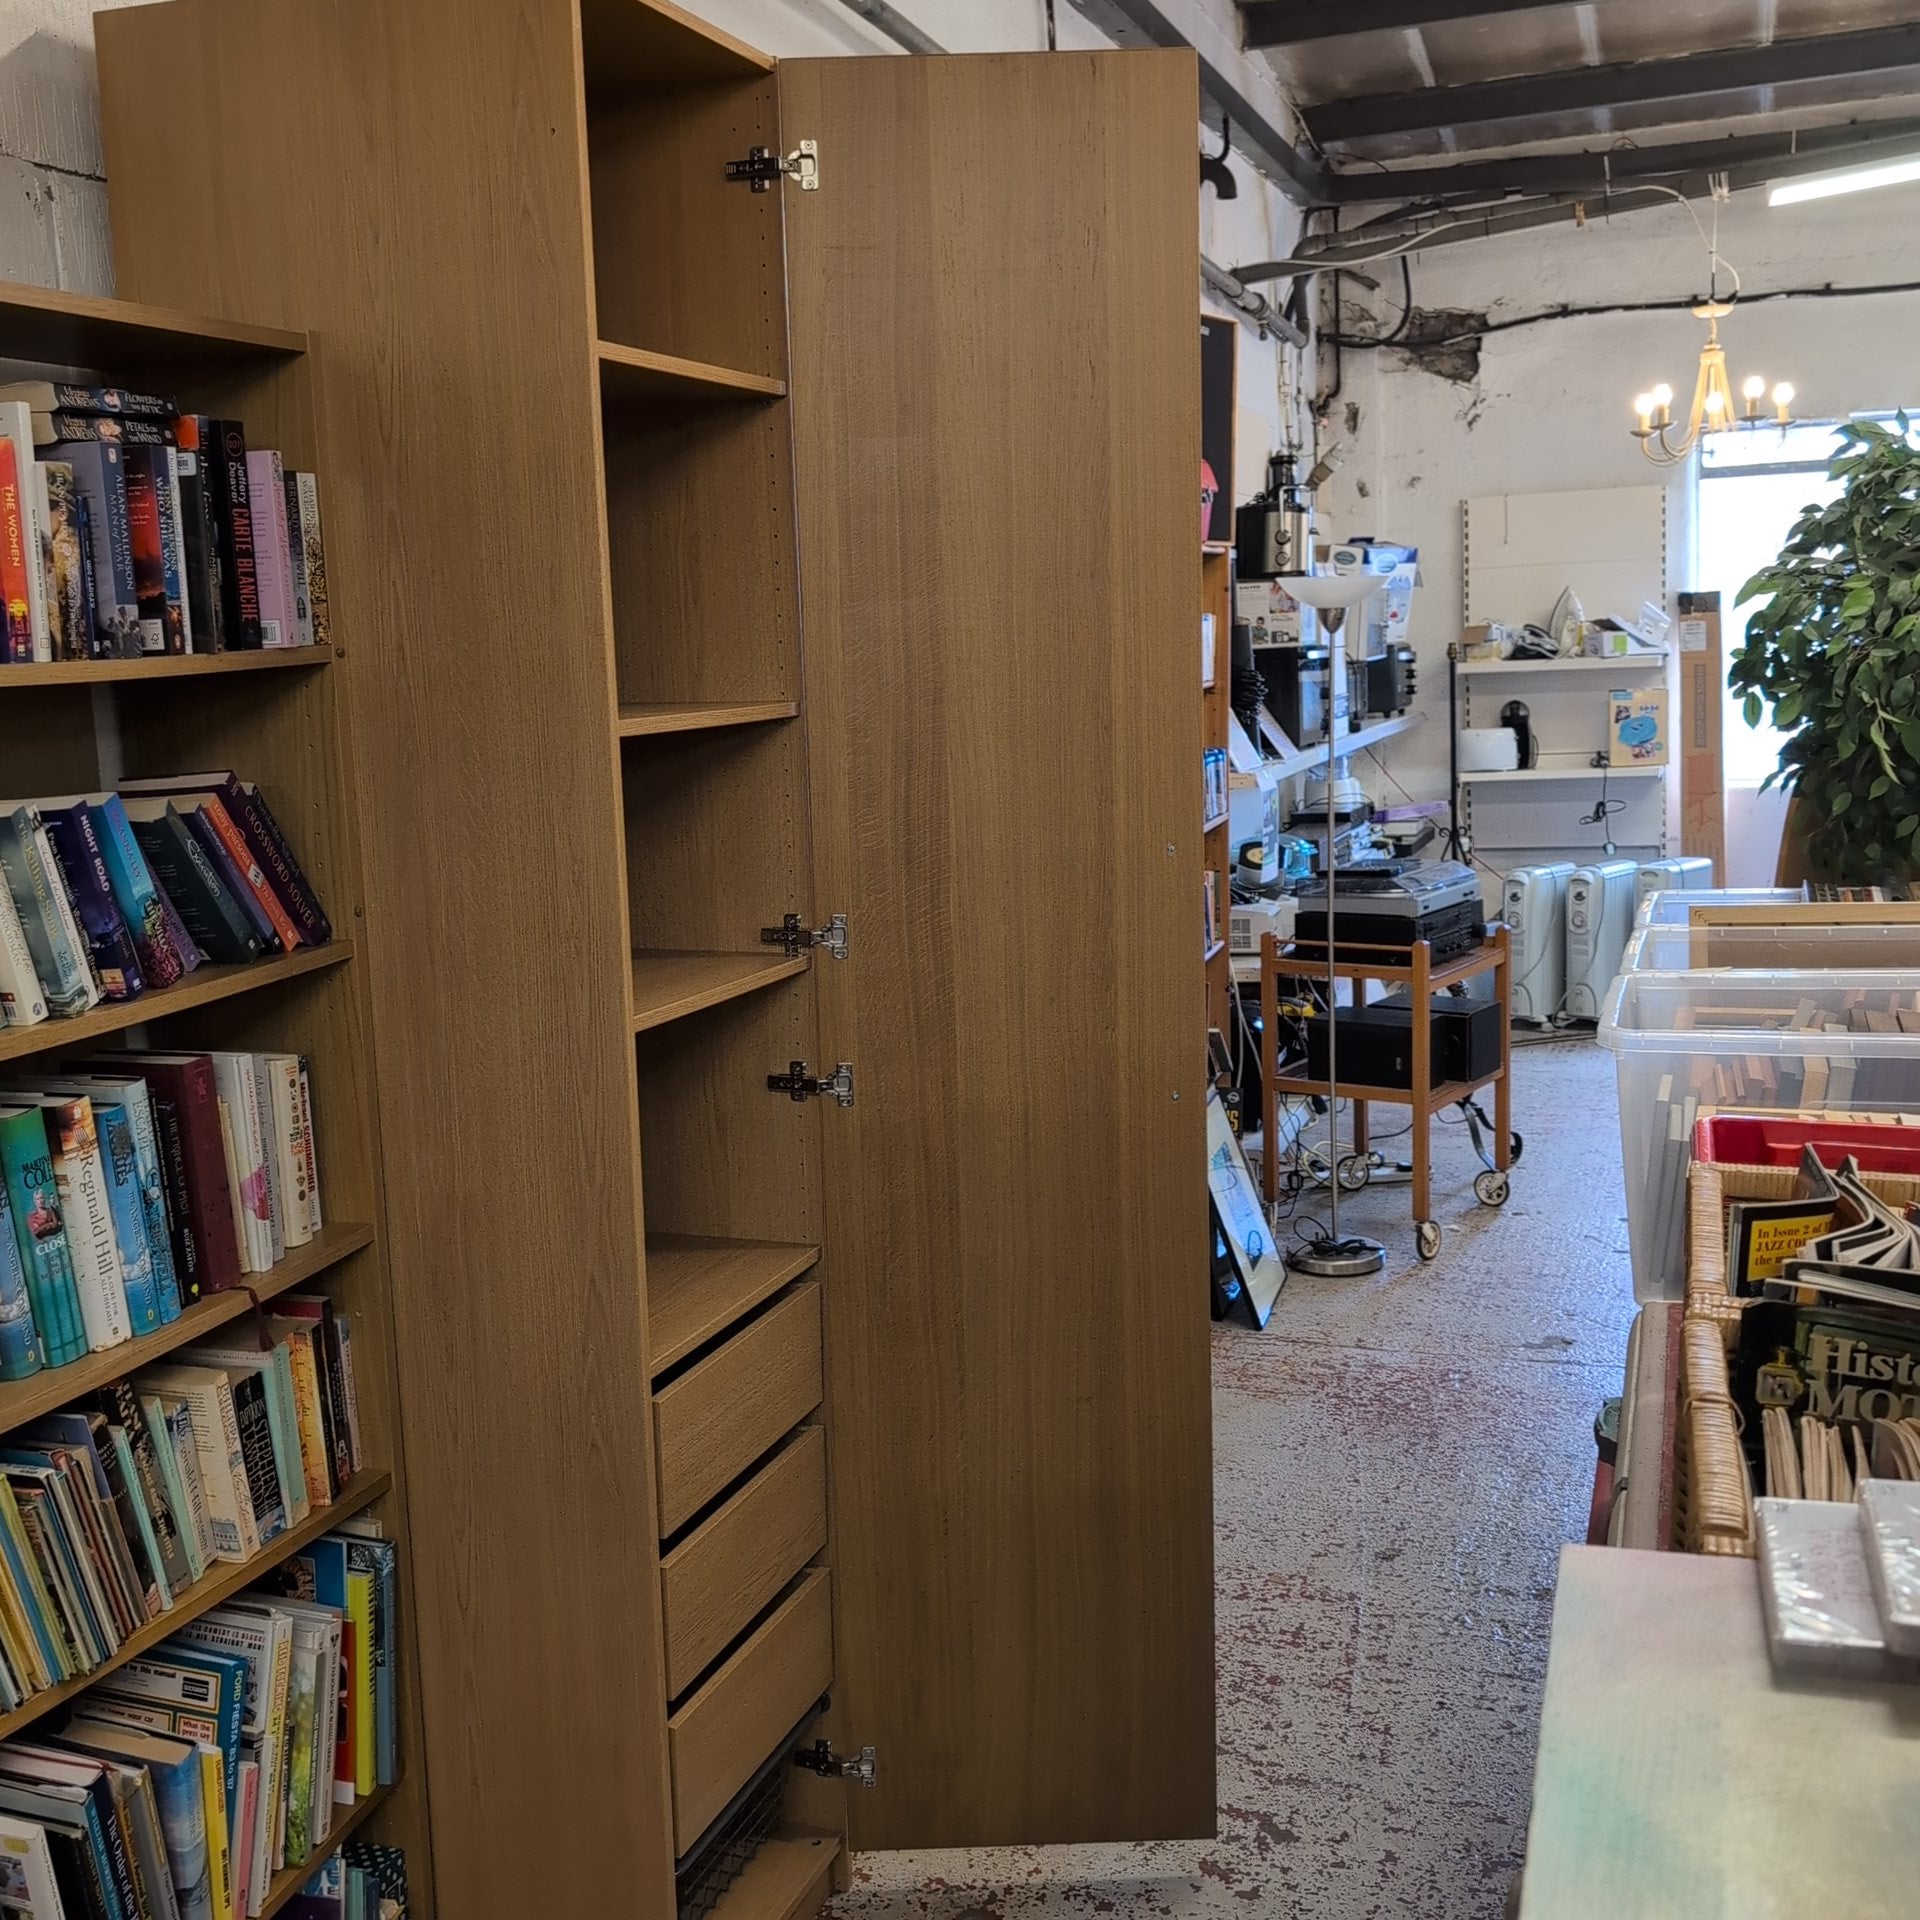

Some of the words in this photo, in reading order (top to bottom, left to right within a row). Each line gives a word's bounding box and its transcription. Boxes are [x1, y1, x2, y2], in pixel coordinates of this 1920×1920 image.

[61, 394, 100, 408] ANDREWS
[125, 393, 155, 405] FLOWERS
[141, 405, 163, 414] ATTIC
[62, 424, 98, 439] ANDREWS
[125, 421, 149, 432] PETALS
[137, 433, 162, 443] WIND
[4, 484, 15, 510] THE
[55, 472, 64, 498] JEAN
[115, 474, 126, 514] ALLAN
[156, 476, 166, 512] WHO
[109, 494, 120, 525] MAN
[164, 486, 173, 515] TONY
[287, 481, 298, 528] BERNARD
[9, 515, 20, 567] WOMEN
[112, 528, 121, 539] of
[159, 515, 170, 545] SHE
[232, 508, 252, 551] CARTE
[115, 542, 123, 572] WAR
[119, 519, 133, 590] MALLINSON
[167, 520, 177, 571] PARSONS
[163, 549, 173, 578] WAS
[237, 559, 257, 622] BLANCHE
[213, 802, 228, 826] tony
[227, 829, 250, 866] parsons
[80, 814, 97, 853] NIGHT
[93, 857, 109, 892] ROAD
[186, 837, 221, 897] Execution
[244, 805, 288, 883] CROSSWORD
[287, 885, 315, 929] SOLVER
[18, 821, 29, 840] The
[25, 845, 46, 899] Killing
[40, 899, 57, 941] Song
[130, 861, 142, 880] LEY
[153, 924, 169, 952] VILLA
[299, 1081, 308, 1122] Michael
[132, 1101, 150, 1154] ESCAPE
[22, 1154, 51, 1173] MARTIN
[260, 1137, 269, 1162] HINCH
[302, 1124, 315, 1192] SCHUMACHER
[24, 1163, 53, 1189] COLE
[264, 1163, 273, 1200] YOURSELF
[79, 1156, 106, 1237] Reginald
[94, 1239, 114, 1276] Hill
[1758, 1229, 1769, 1238] In
[1774, 1228, 1800, 1237] Issue
[1803, 1224, 1809, 1234] 2
[1812, 1223, 1822, 1233] of
[36, 1234, 67, 1255] CLOSE
[129, 1206, 144, 1248] ANGEL'S
[137, 1248, 154, 1305] COMMAND
[1756, 1240, 1784, 1252] JAZZ
[1755, 1256, 1772, 1266] the
[5, 1242, 23, 1286] ANGEL'S
[14, 1288, 34, 1346] COMMAND
[102, 1292, 116, 1327] DISEASES
[221, 1385, 236, 1443] PHILIPPA
[242, 1428, 264, 1503] LAWHEAD
[258, 1418, 278, 1492] STEPHEN
[161, 1534, 175, 1559] TITLE
[204, 1626, 230, 1636] COMEDY
[212, 1635, 244, 1647] STRAIGHT
[275, 1639, 289, 1666] REID
[129, 1664, 137, 1672] by
[141, 1665, 151, 1674] this
[154, 1670, 177, 1679] manual
[233, 1669, 244, 1701] FORD
[272, 1666, 286, 1713] FLEMING
[182, 1720, 198, 1729] What
[182, 1729, 198, 1737] press
[200, 1733, 210, 1741] say
[229, 1703, 242, 1743] FIESTA
[227, 1744, 238, 1761] '83
[227, 1762, 235, 1773] to
[89, 1807, 105, 1852] WILLIAM
[104, 1813, 121, 1841] The
[112, 1841, 128, 1878] Order
[119, 1878, 133, 1892] of
[122, 1892, 138, 1915] the
